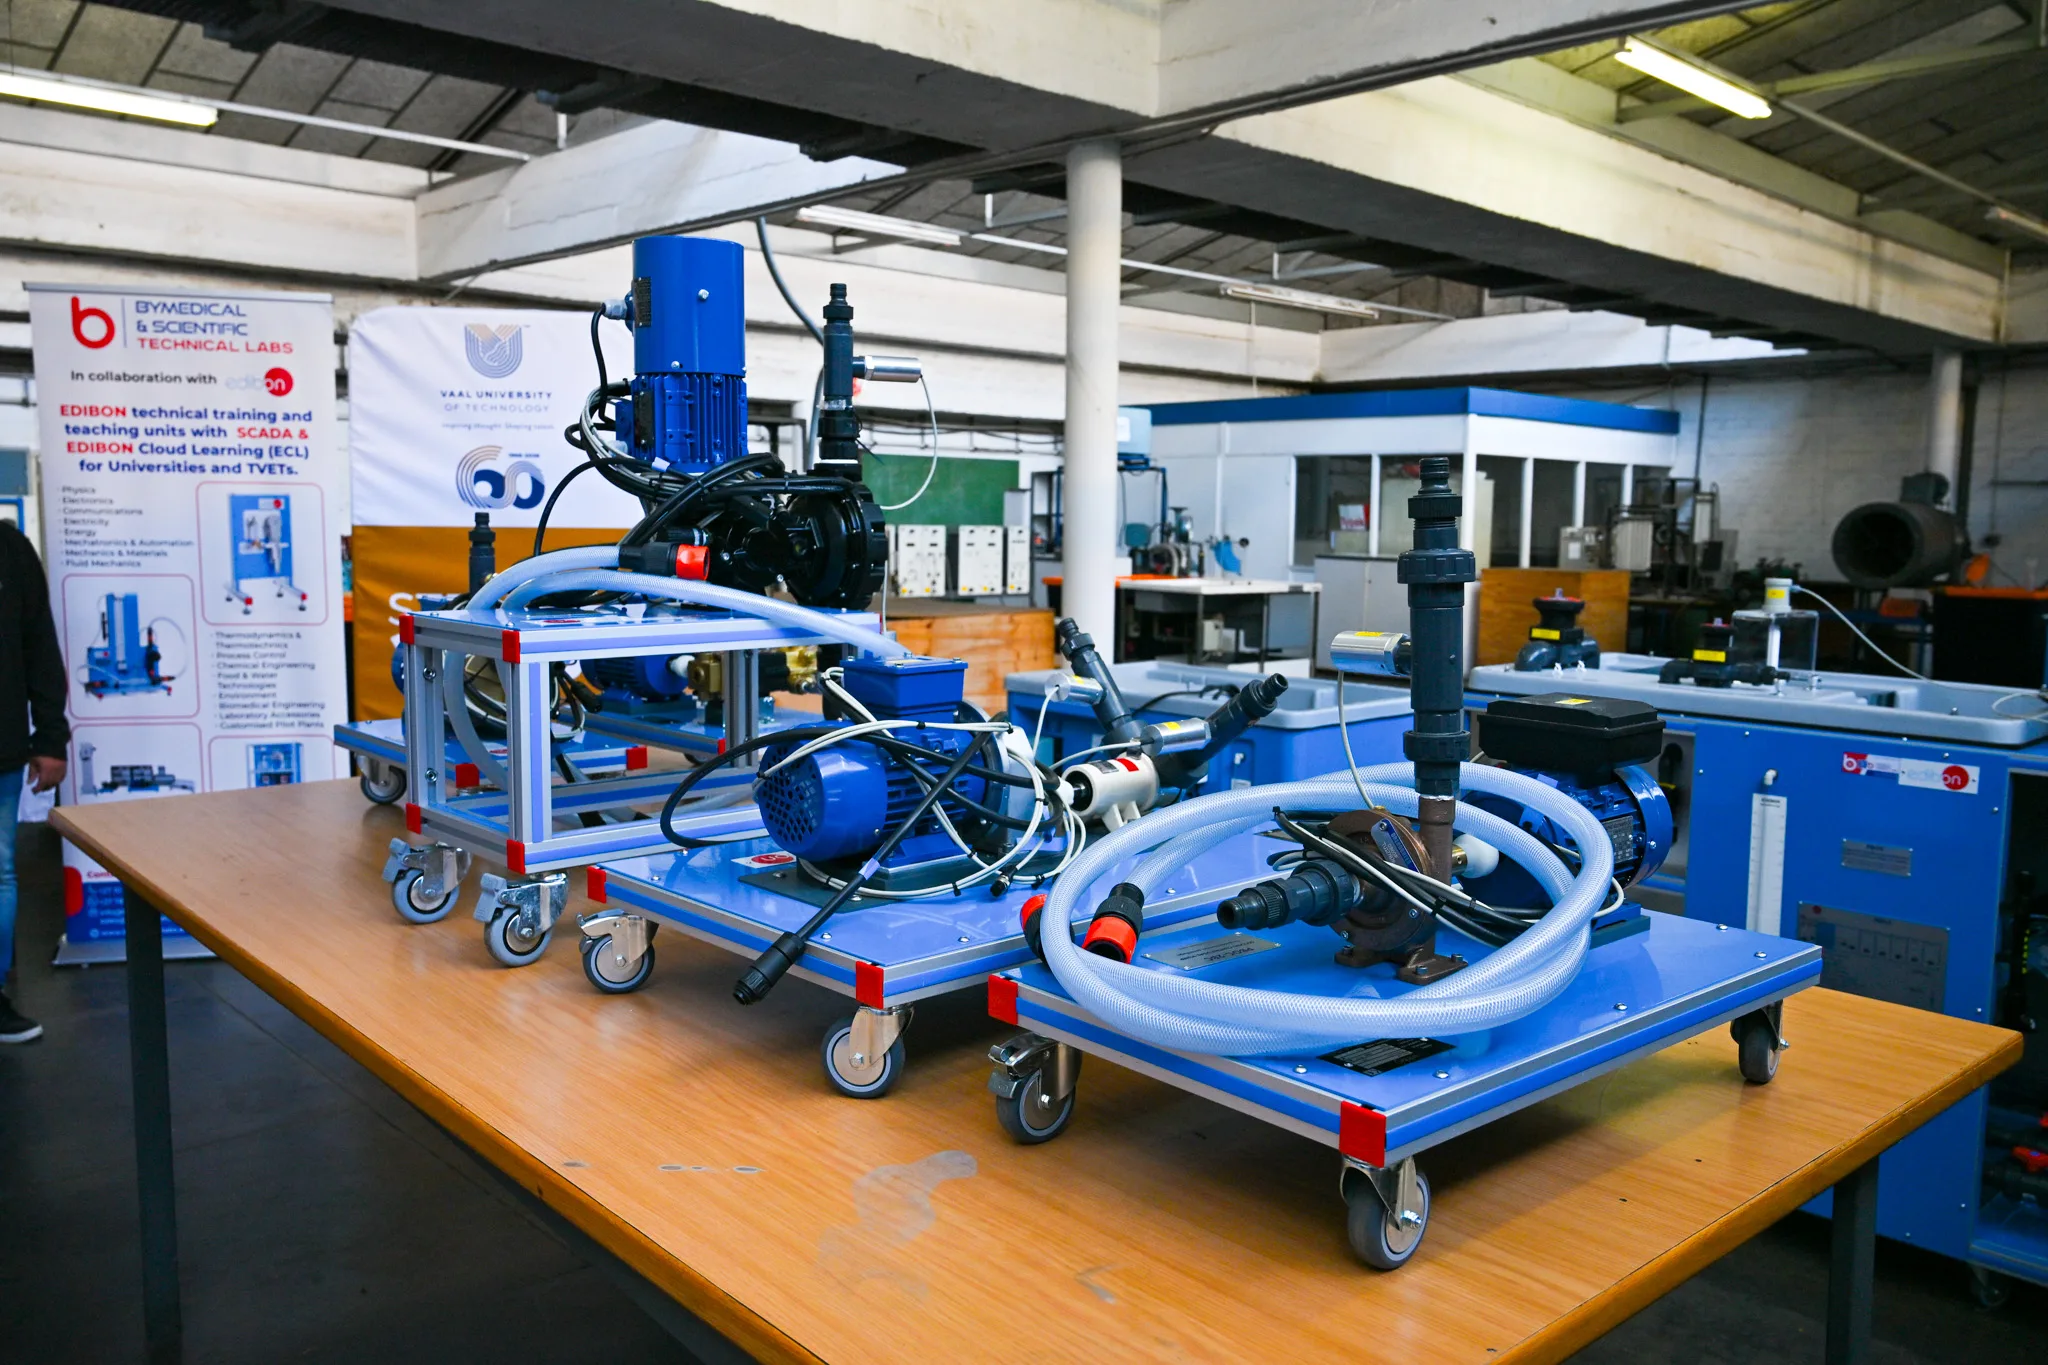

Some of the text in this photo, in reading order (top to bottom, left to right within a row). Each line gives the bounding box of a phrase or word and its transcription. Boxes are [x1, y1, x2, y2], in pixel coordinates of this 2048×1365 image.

[135, 301, 247, 317] BYMEDICAL
[137, 320, 249, 336] & SCIENTIFIC
[137, 338, 294, 354] TECHNICAL LABS
[71, 370, 217, 385] In collaboration with
[440, 390, 552, 399] VAAL UNIVERSITY
[60, 404, 313, 424] EDIBON technical training and
[444, 403, 549, 413] OF TECHNOLOGY
[65, 423, 309, 440] teaching units with SCADA &
[66, 441, 310, 459] EDIBON Cloud Learning (ECL)
[79, 460, 298, 476] for Universities and TVETs.
